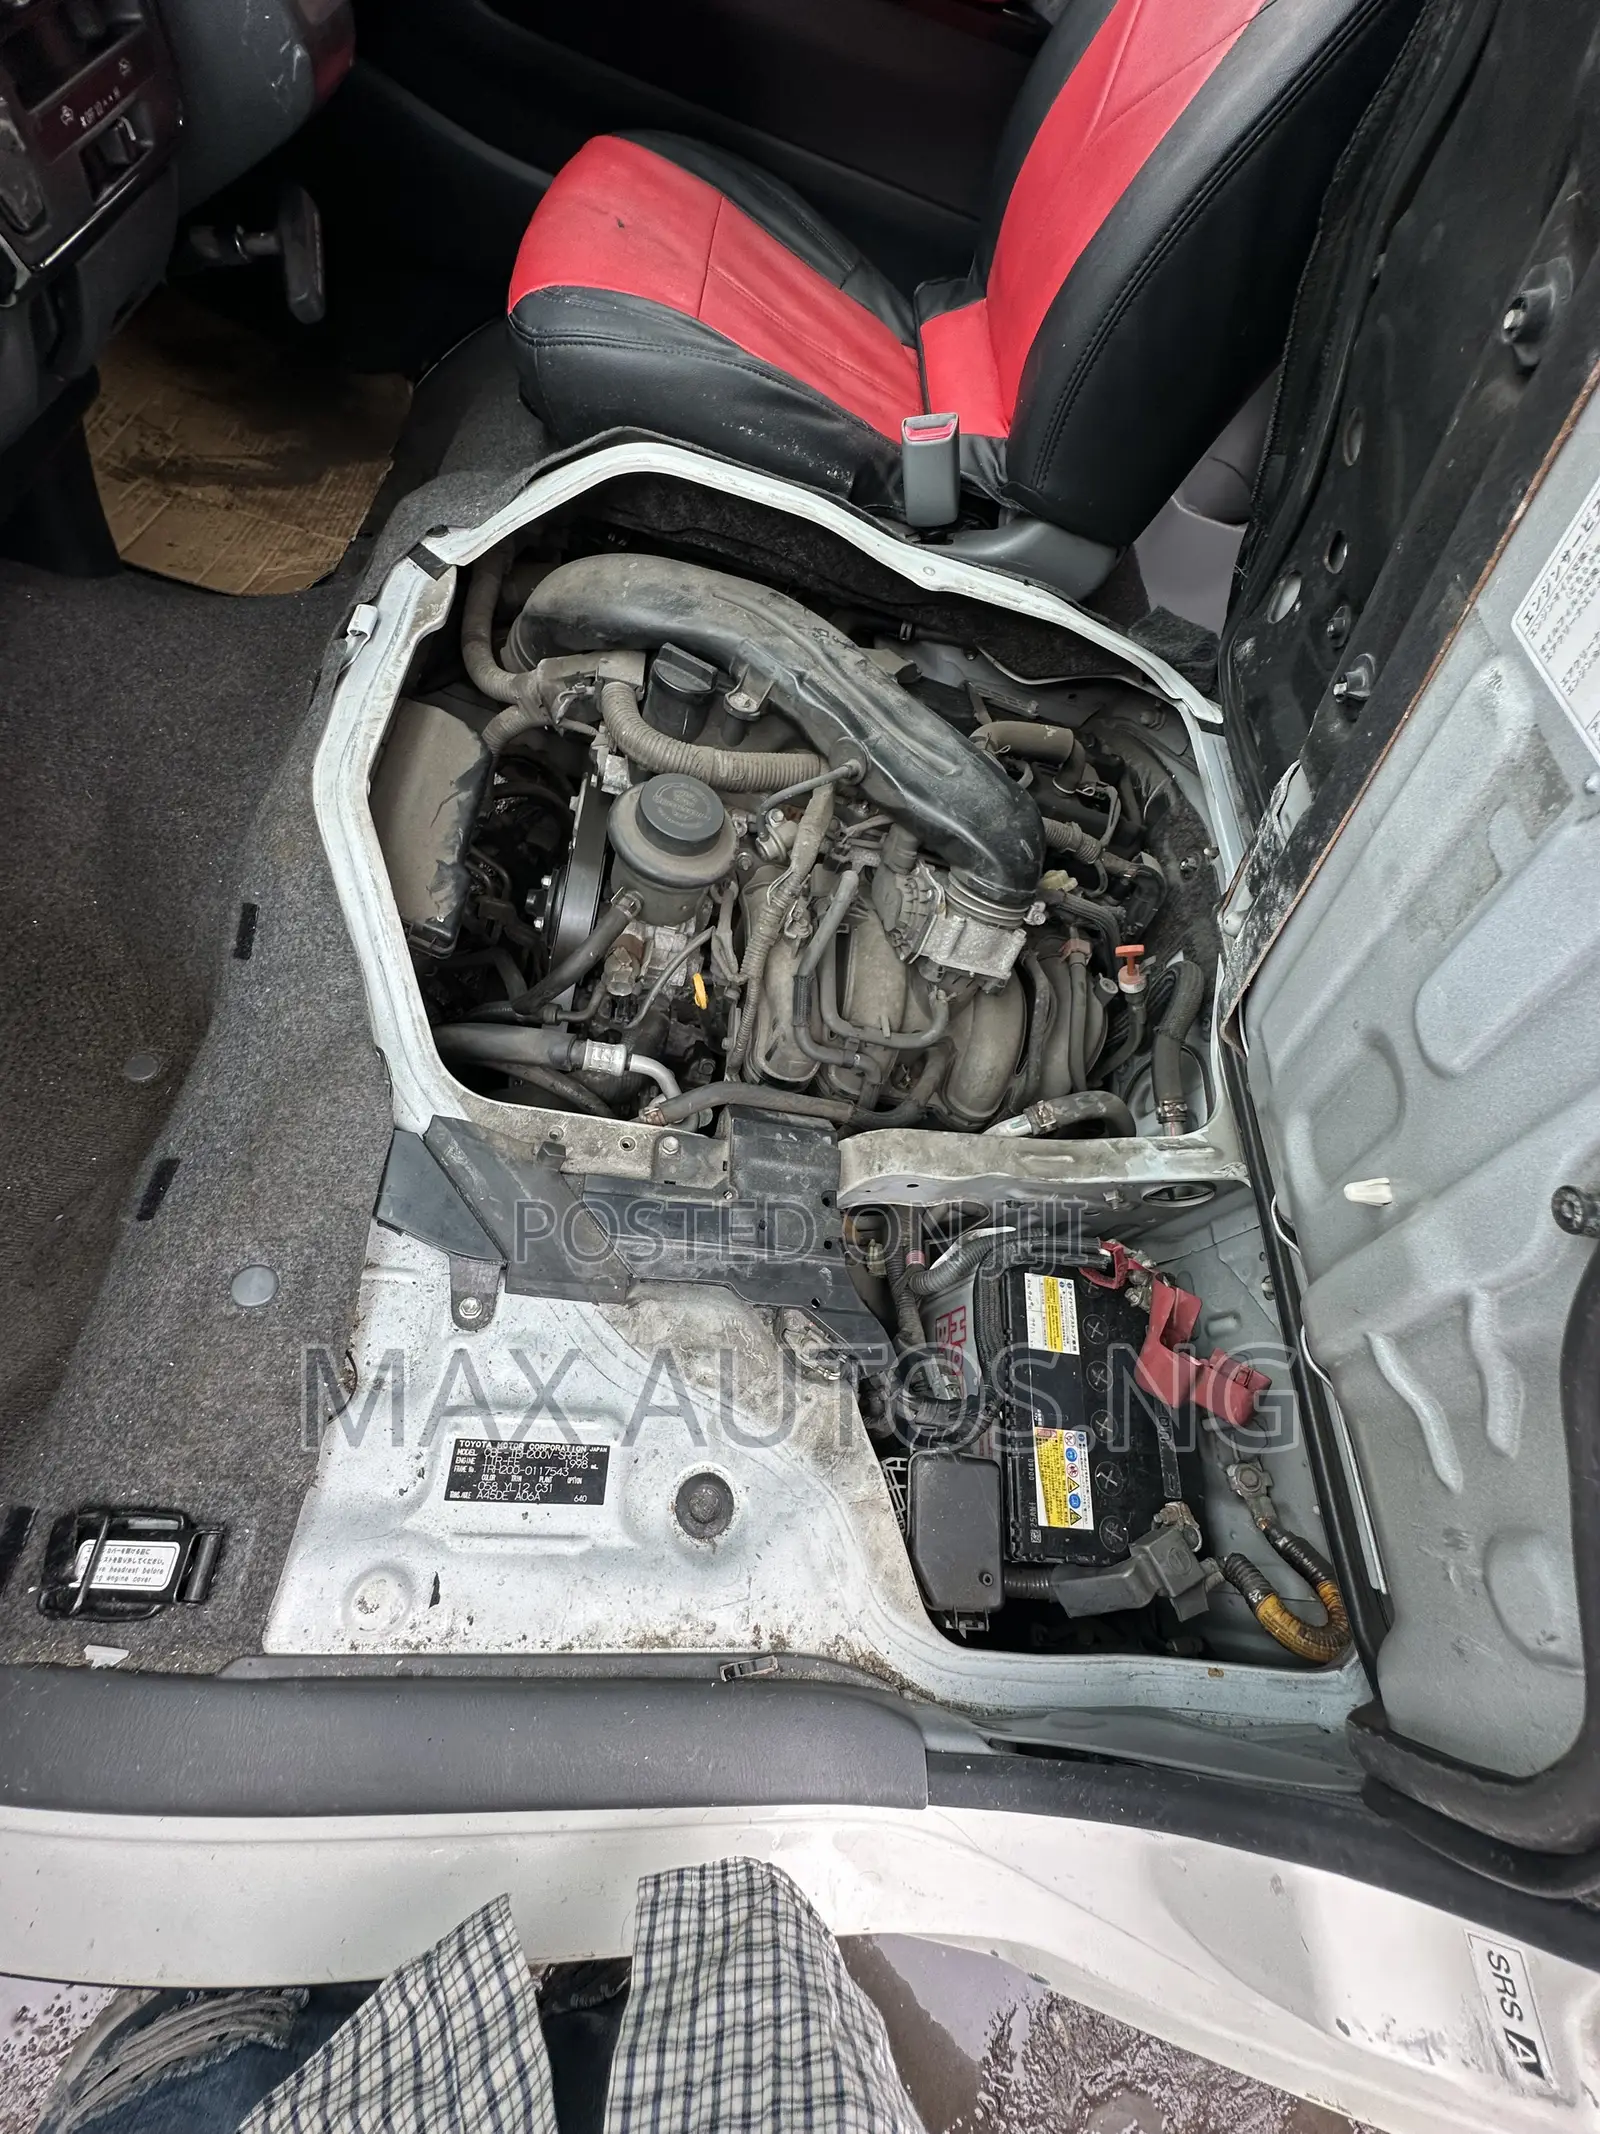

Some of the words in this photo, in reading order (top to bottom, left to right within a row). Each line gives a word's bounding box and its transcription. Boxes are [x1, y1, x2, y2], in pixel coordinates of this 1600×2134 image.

[457, 1448, 478, 1456] MODEL
[459, 1440, 492, 1449] TOYOTA
[497, 1442, 525, 1450] MOTOR
[529, 1443, 587, 1453] CORPORATION
[455, 1456, 477, 1465] ENGINE
[565, 1460, 588, 1470] 1998
[482, 1464, 570, 1477] TRH200-0117543
[504, 1482, 531, 1493] YL12
[535, 1483, 553, 1493] C31
[476, 1490, 509, 1501] A45DE
[515, 1491, 541, 1501] A06A
[573, 1495, 588, 1503] 640
[109, 1565, 139, 1575] headrest
[142, 1566, 164, 1575] before
[1487, 1950, 1524, 2022] SRS
